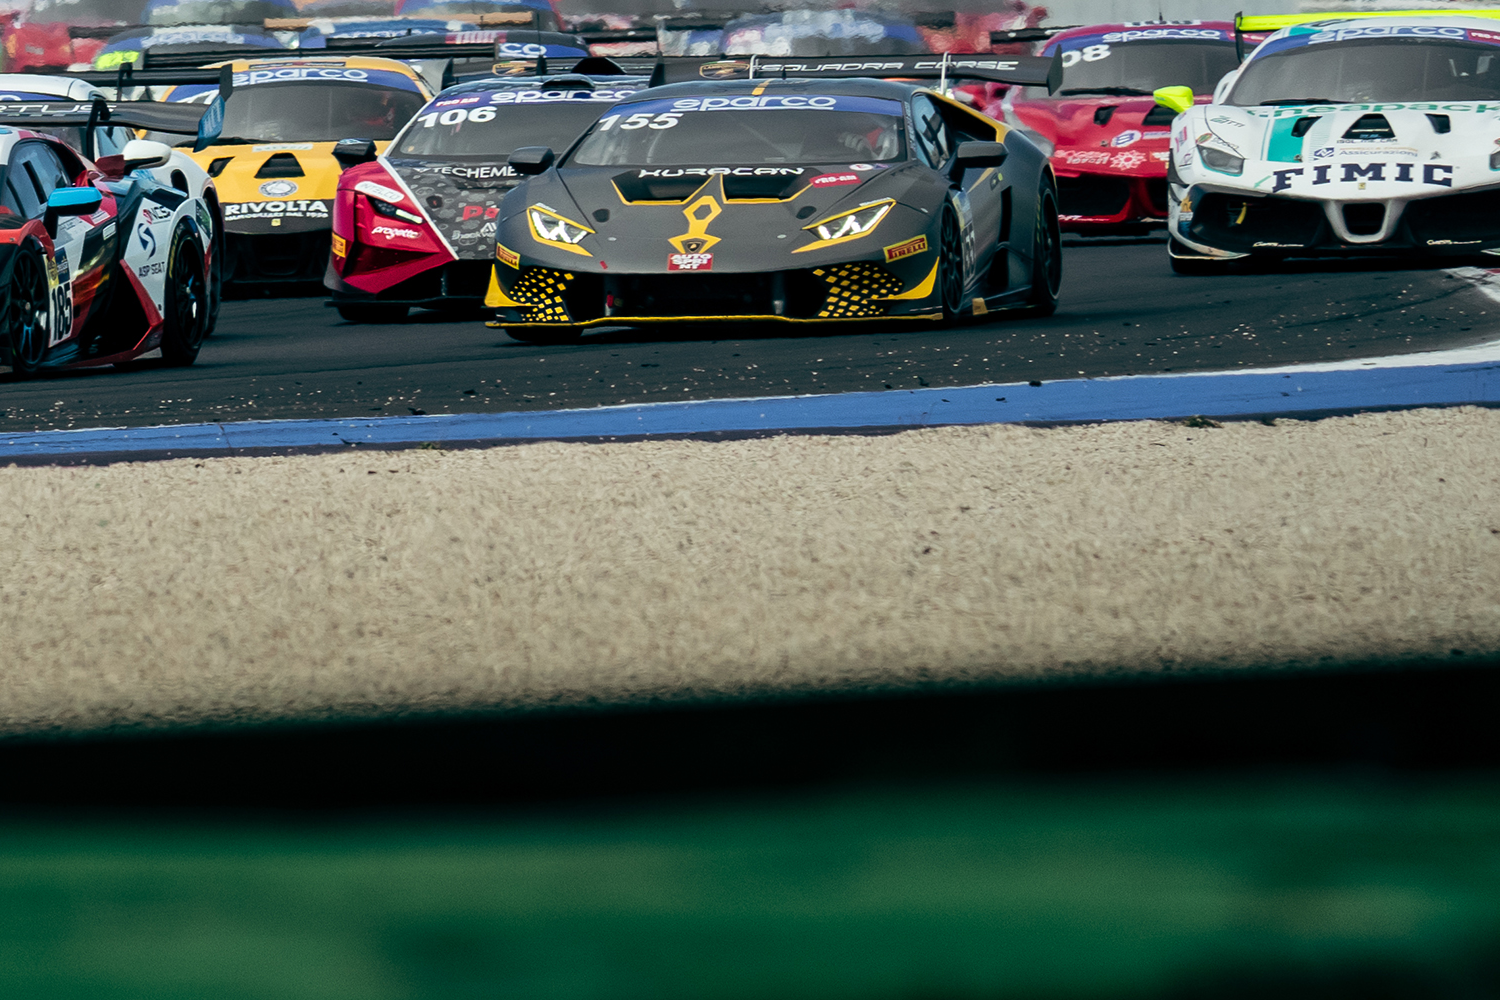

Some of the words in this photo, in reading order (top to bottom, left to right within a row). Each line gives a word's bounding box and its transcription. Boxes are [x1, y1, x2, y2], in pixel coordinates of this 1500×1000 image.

[1102, 29, 1221, 42] sparco
[1308, 26, 1466, 42] sparco
[757, 62, 904, 72] SQUADRA
[231, 66, 368, 85] sparco
[489, 90, 637, 104] sparco
[670, 96, 837, 112] sparco
[417, 106, 498, 128] 106
[598, 112, 684, 132] 155
[433, 165, 524, 179] TECHEME
[1272, 163, 1454, 194] FIMIC
[224, 200, 329, 216] RIVOLTA
[51, 281, 72, 341] 185
